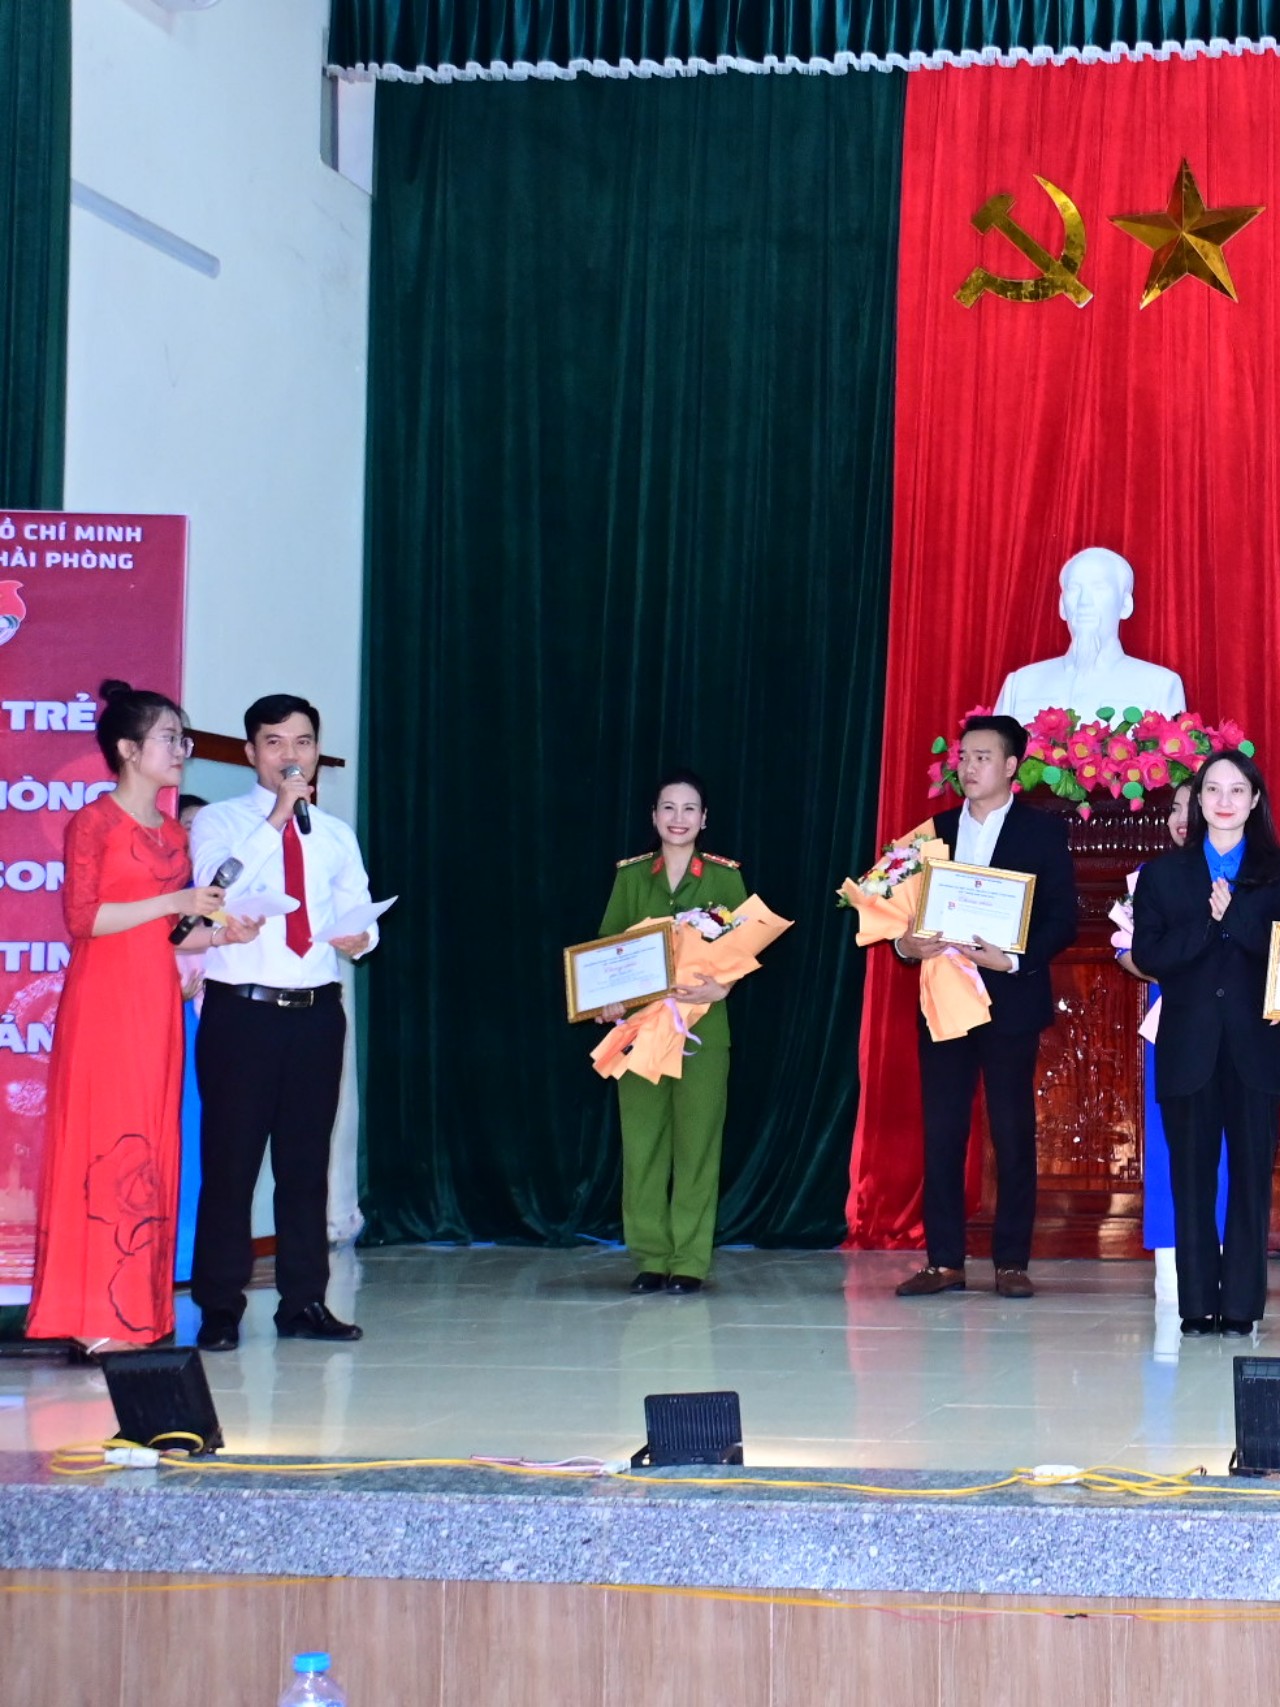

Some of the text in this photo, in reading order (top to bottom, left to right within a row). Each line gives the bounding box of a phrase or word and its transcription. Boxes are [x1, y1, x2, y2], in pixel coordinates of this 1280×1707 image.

[0, 517, 142, 543] Ồ CHÍ MINH
[0, 545, 134, 570] HẢI PHÒNG
[1, 692, 97, 731] TRẺ
[0, 860, 65, 892] ON
[0, 1014, 55, 1053] ẢN
